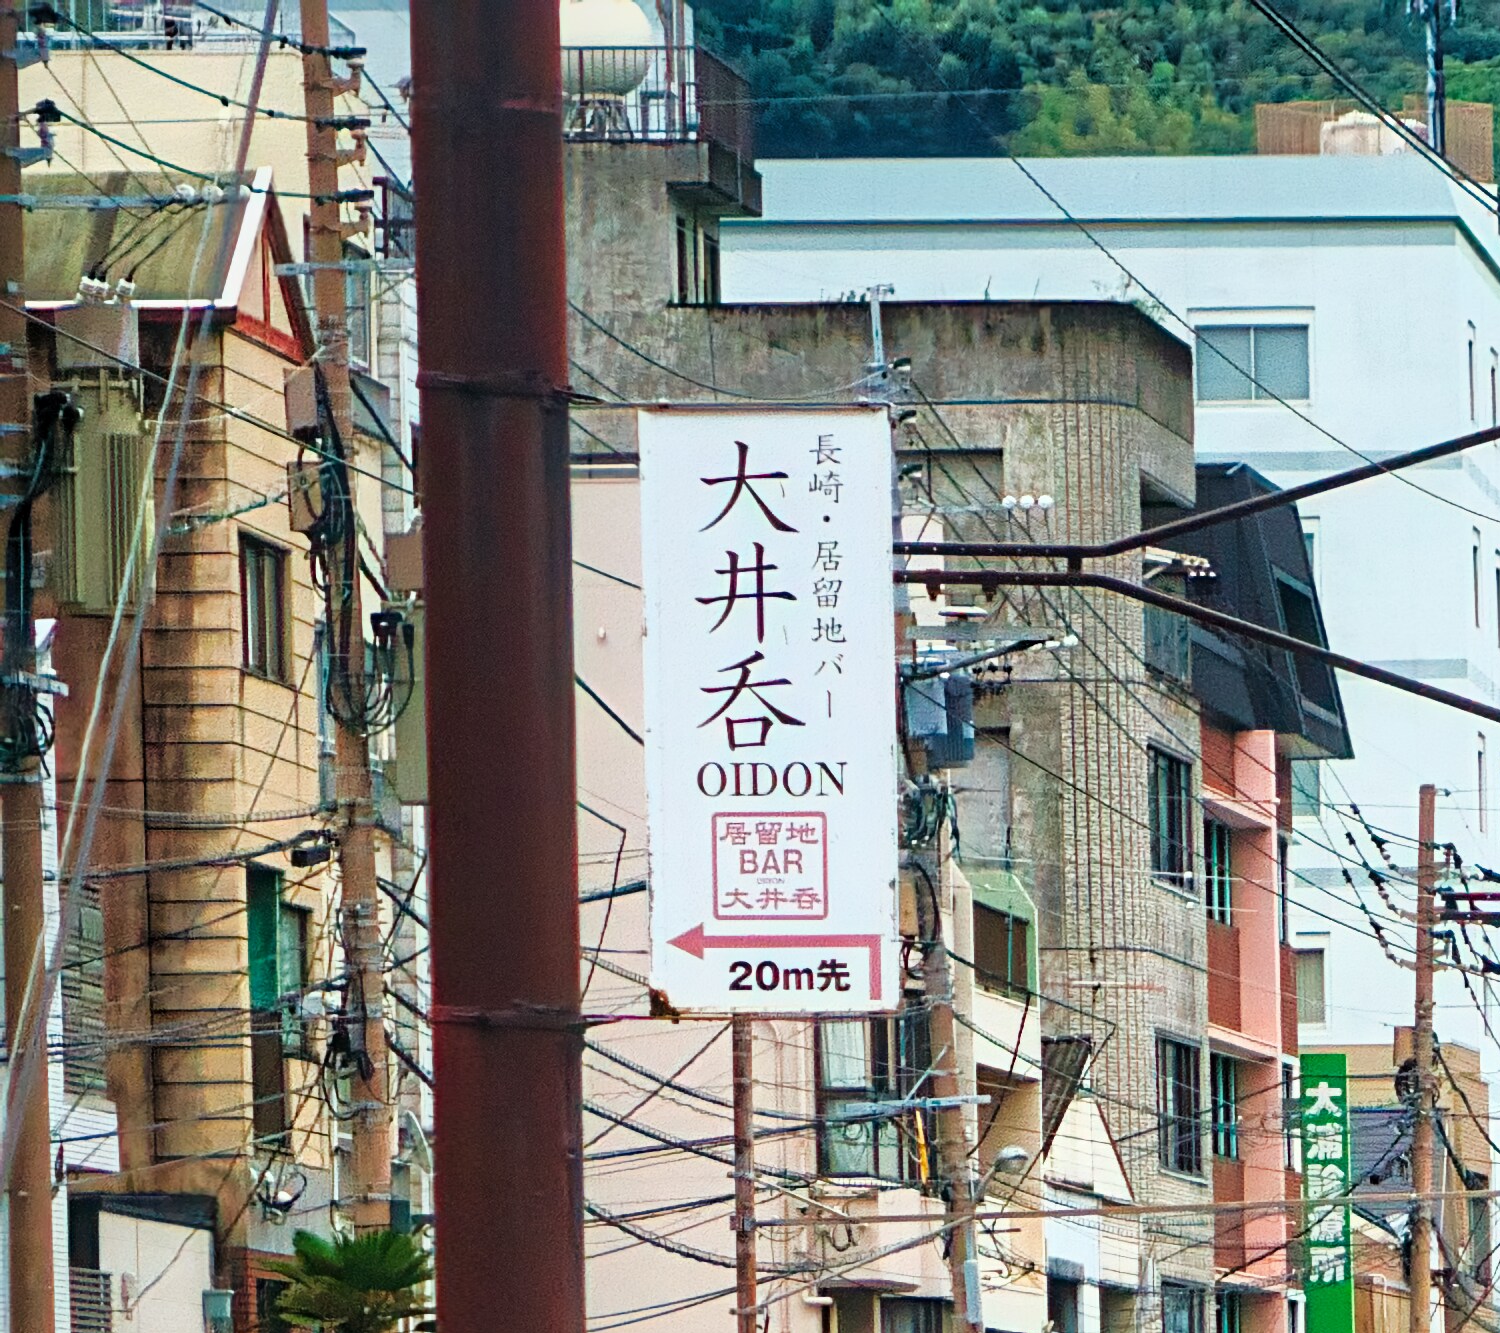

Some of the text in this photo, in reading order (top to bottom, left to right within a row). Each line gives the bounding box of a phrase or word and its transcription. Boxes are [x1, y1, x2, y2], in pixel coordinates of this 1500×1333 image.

[809, 434, 847, 718] 長崎・居留地バー
[695, 440, 806, 751] 大井呑
[697, 761, 848, 797] OIDON
[720, 821, 819, 846] 居留地
[739, 849, 803, 874] BAR
[728, 959, 851, 992] 20m先
[1305, 1081, 1346, 1282] 大浦診療所
